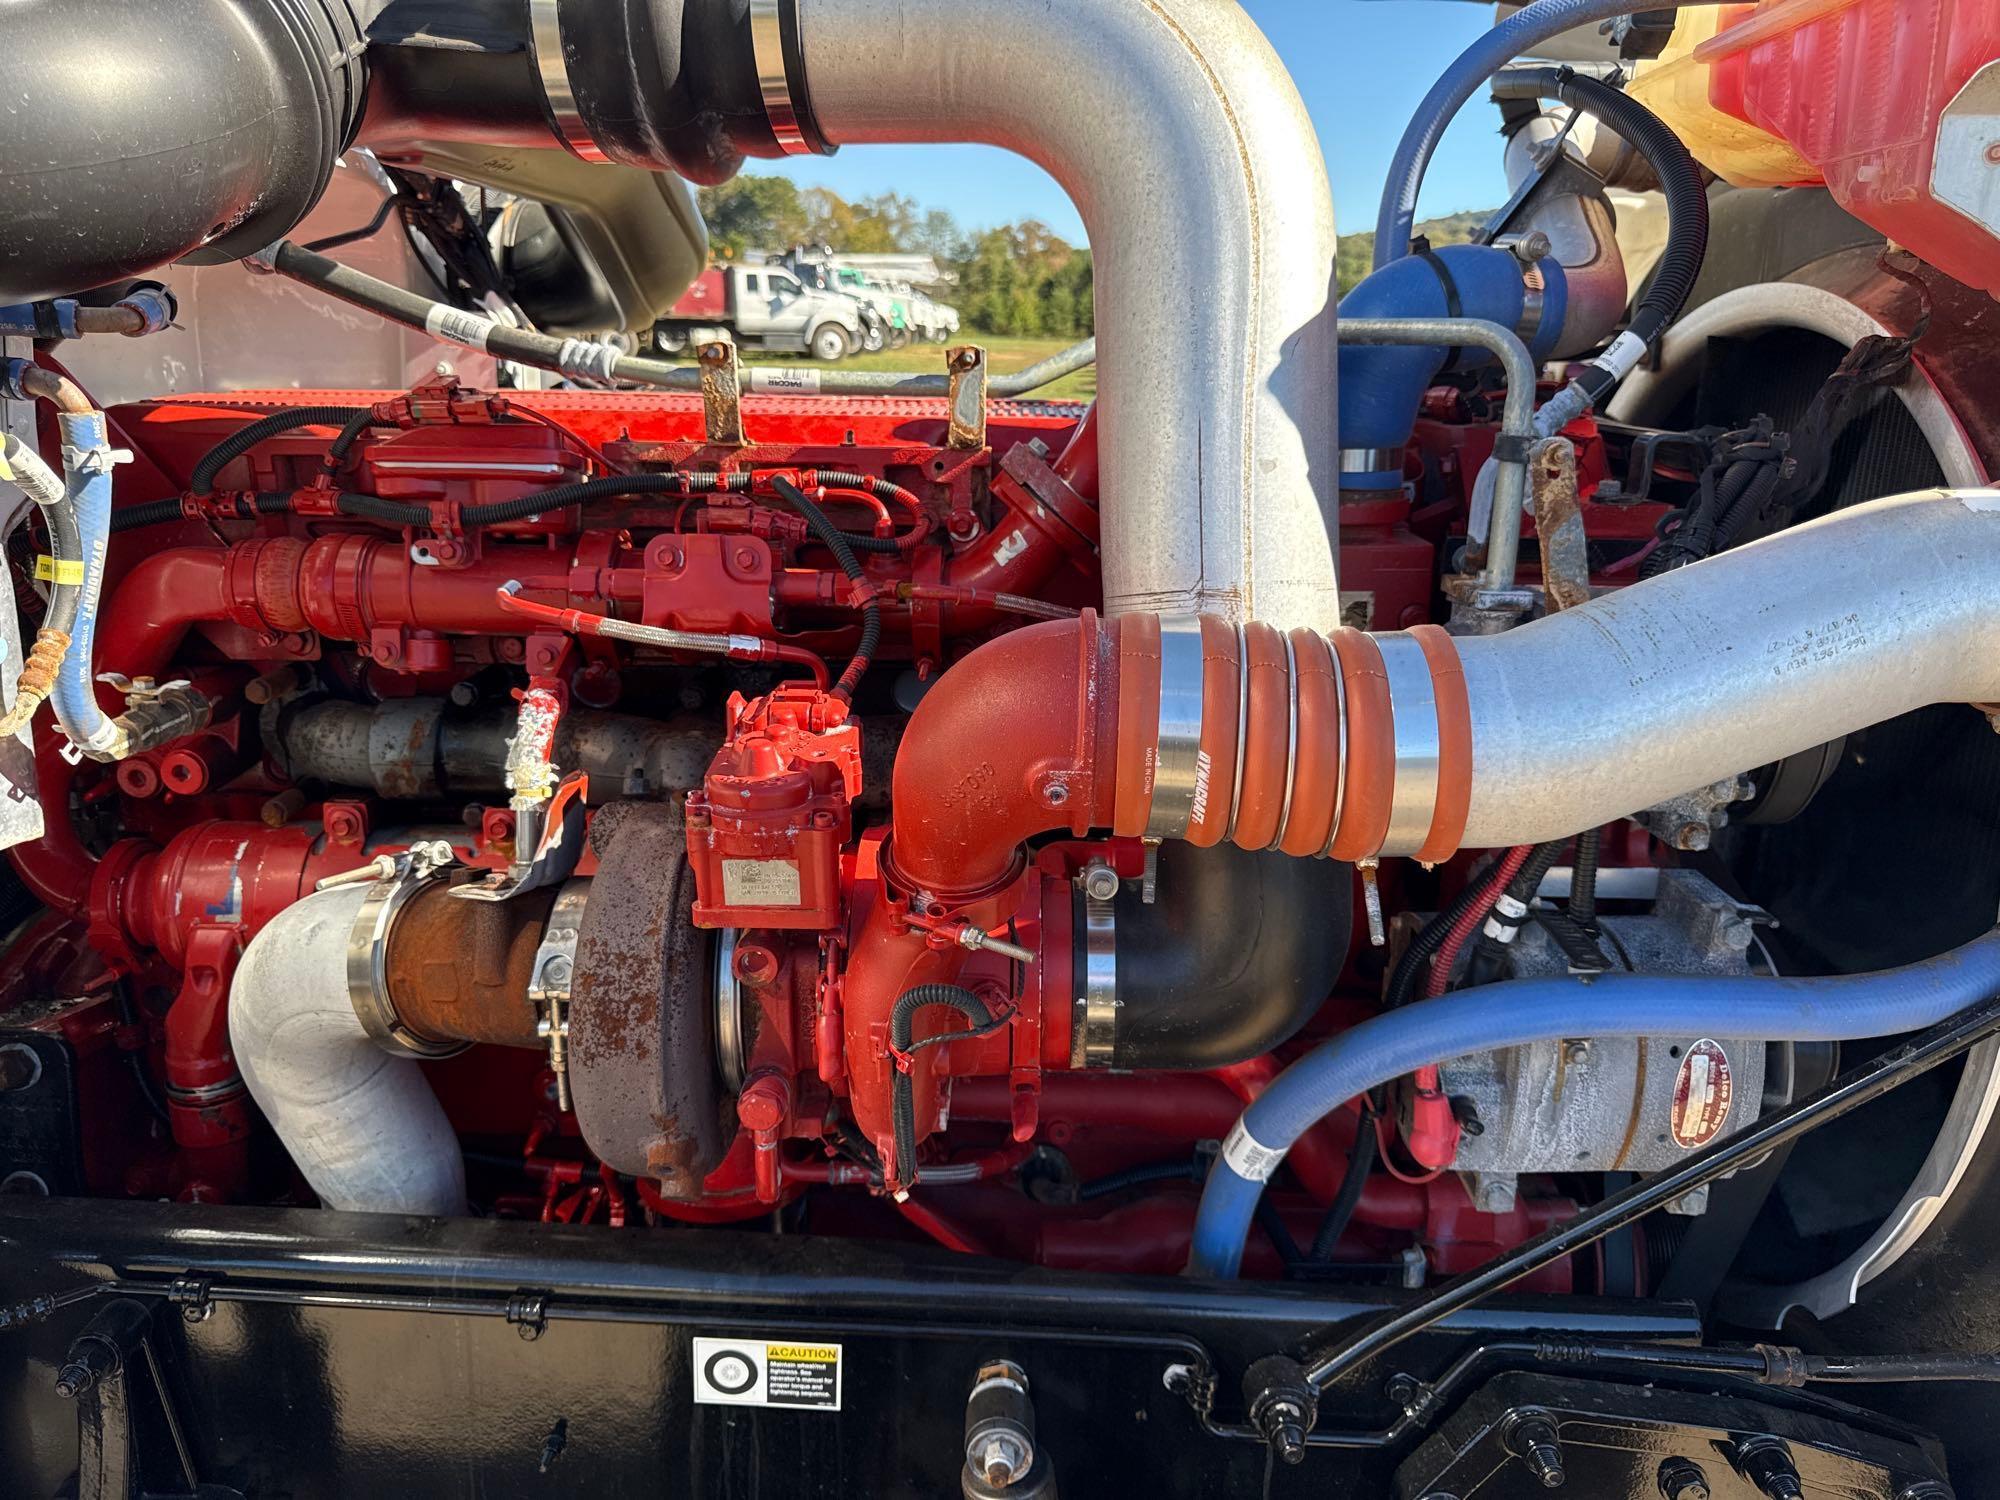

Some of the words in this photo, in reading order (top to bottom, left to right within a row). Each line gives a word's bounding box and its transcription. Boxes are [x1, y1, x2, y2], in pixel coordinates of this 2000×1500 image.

[1143, 775, 1152, 795] CHINA
[1192, 750, 1211, 825] DYNACRAFT
[1720, 1064, 1729, 1099] Delco
[1710, 1101, 1729, 1131] Remy
[779, 1347, 836, 1359] CAUTION
